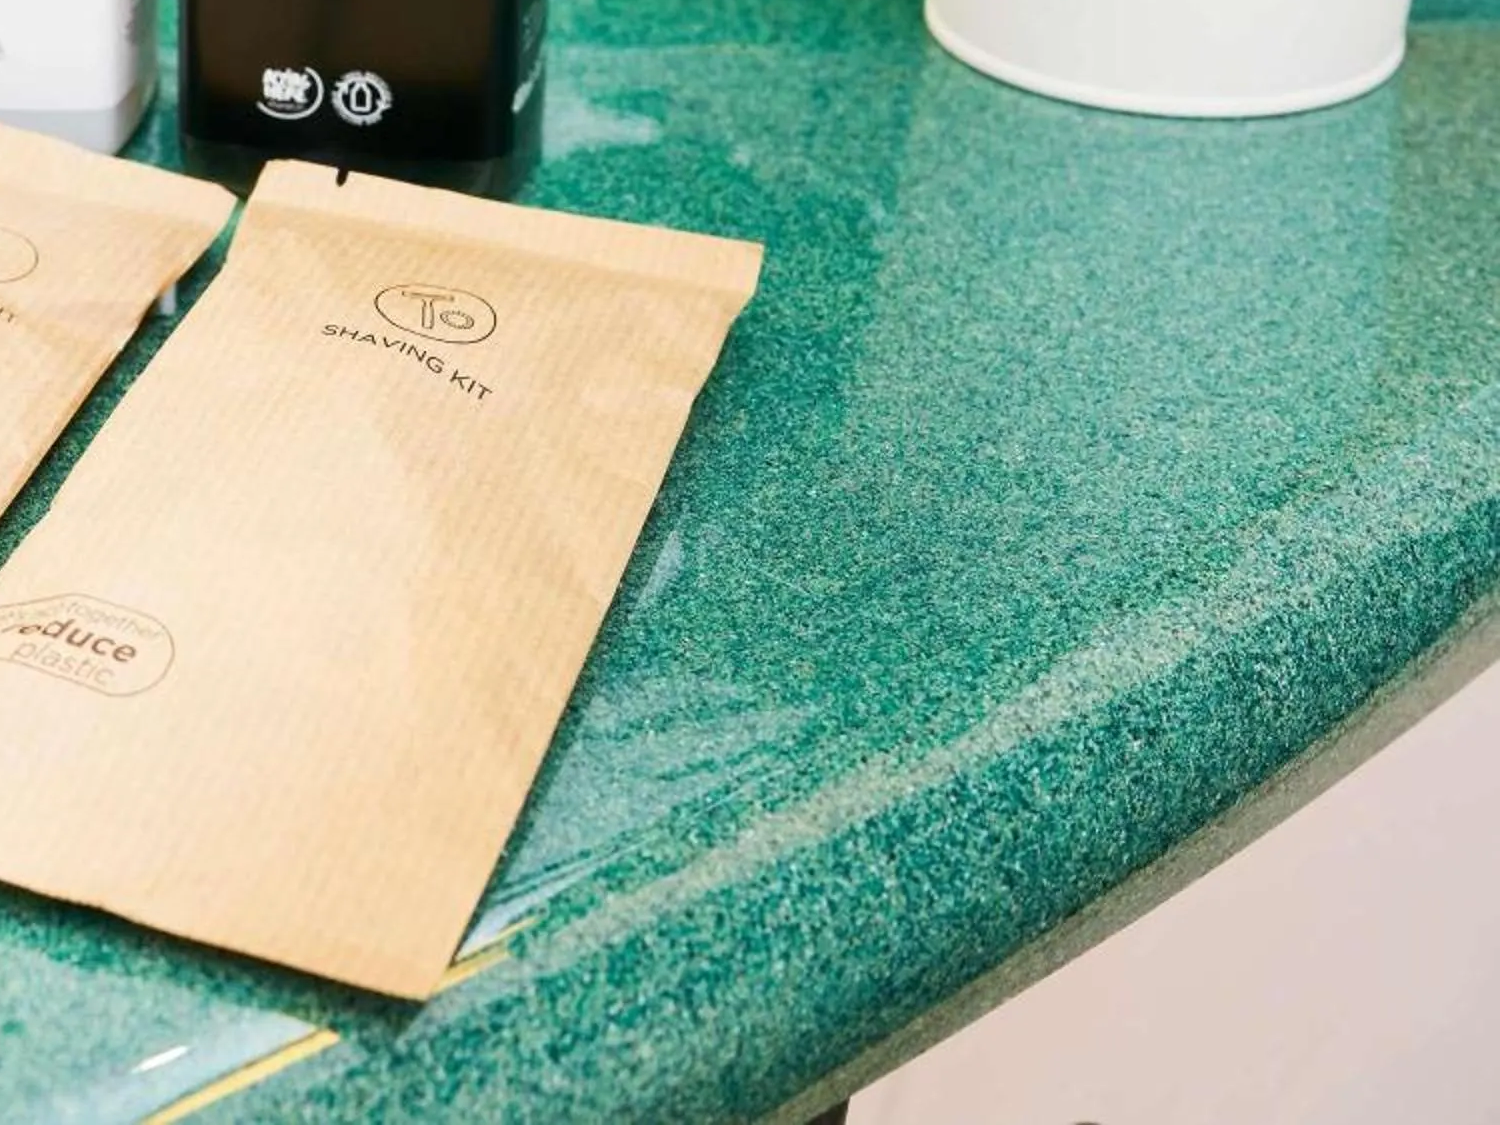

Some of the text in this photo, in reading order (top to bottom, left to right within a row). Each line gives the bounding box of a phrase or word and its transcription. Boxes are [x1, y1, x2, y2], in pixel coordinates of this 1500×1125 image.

[321, 324, 493, 400] SHAVING KIT
[9, 640, 115, 686] plastic
